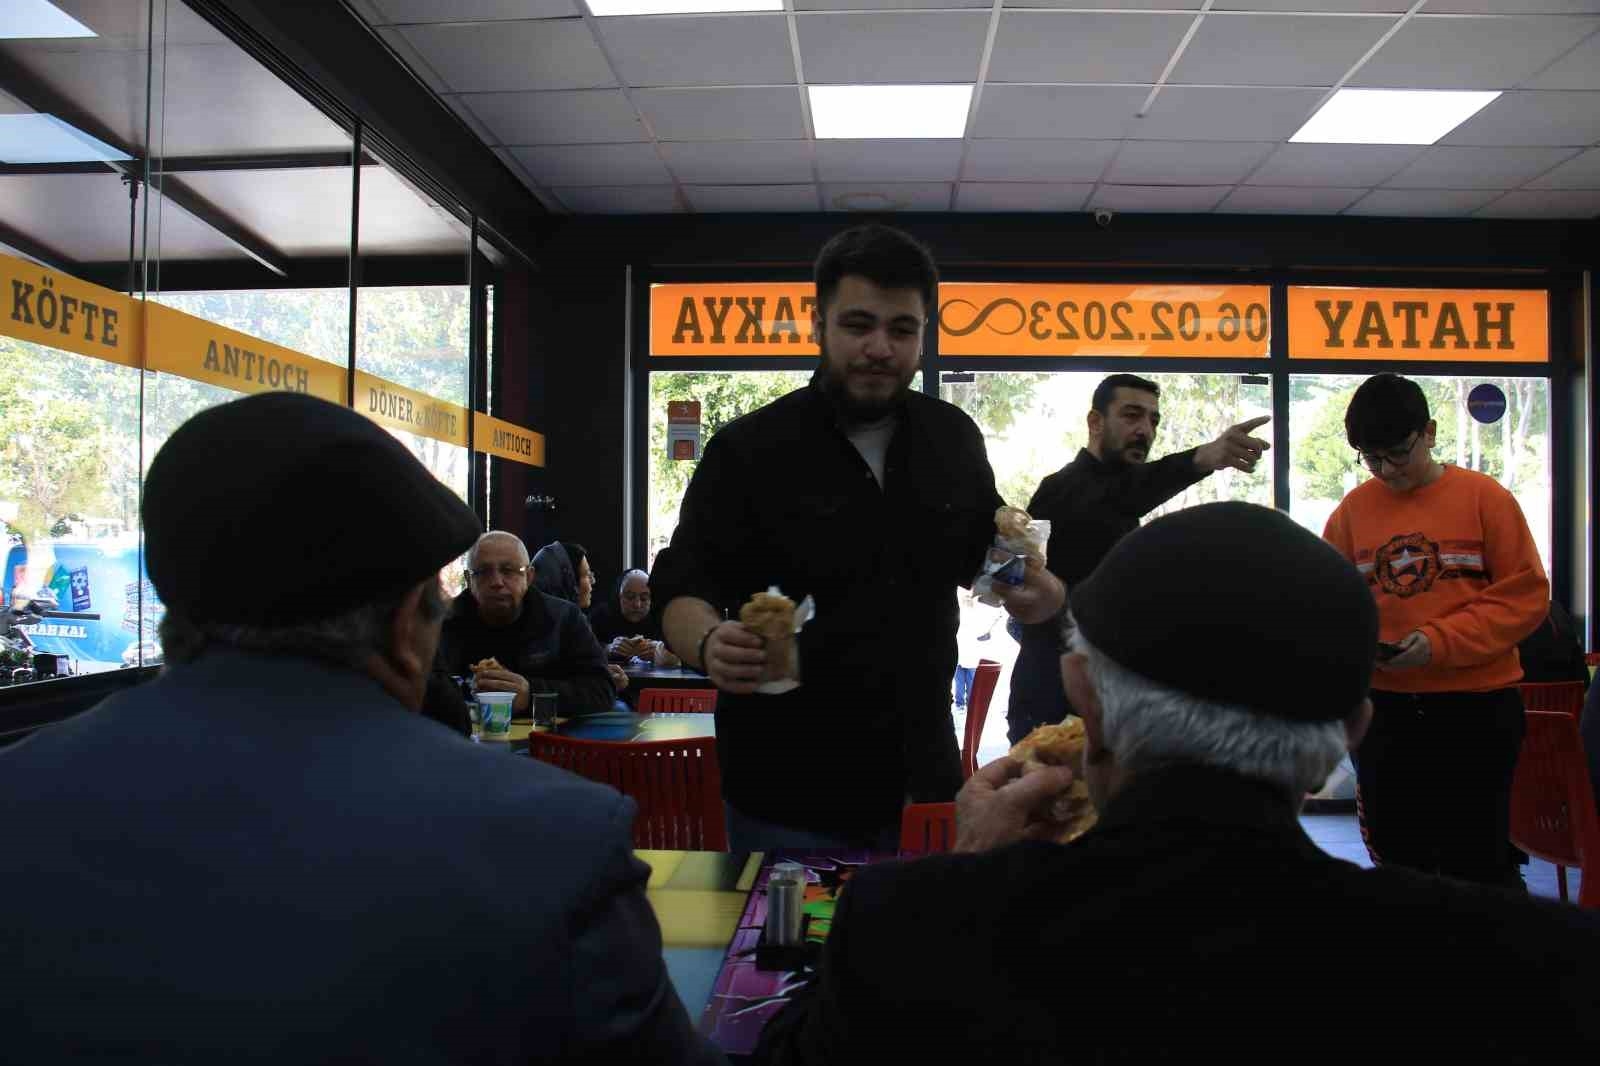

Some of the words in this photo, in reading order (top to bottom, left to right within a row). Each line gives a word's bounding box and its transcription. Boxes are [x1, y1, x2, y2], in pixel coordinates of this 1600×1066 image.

[11, 276, 118, 347] KÖFTE
[203, 339, 309, 393] ANTIOCH
[369, 385, 413, 424] DÖNER
[492, 428, 532, 457] ANTIOCH
